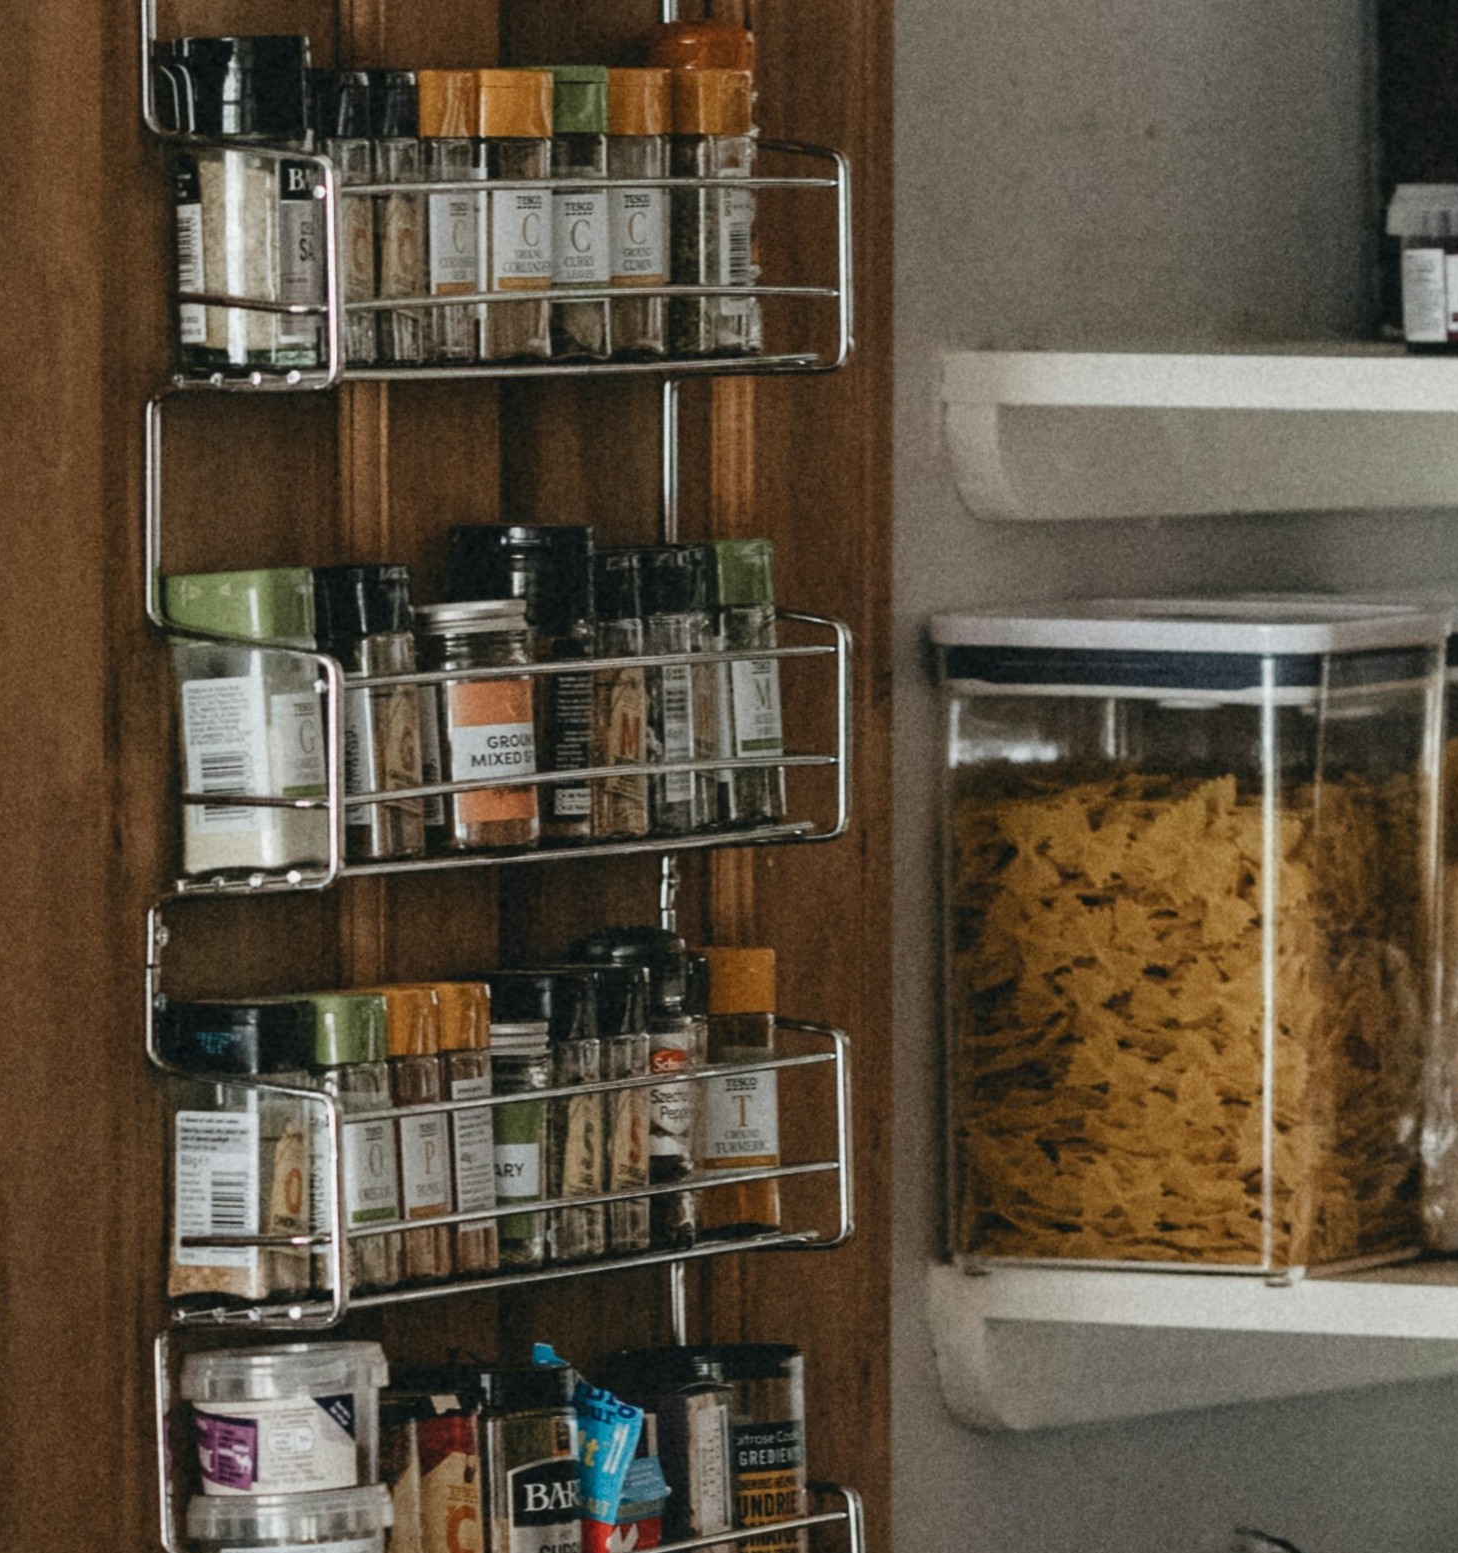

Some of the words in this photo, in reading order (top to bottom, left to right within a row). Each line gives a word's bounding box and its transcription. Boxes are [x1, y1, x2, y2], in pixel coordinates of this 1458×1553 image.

[564, 202, 595, 212] TESCO
[570, 219, 591, 253] C
[627, 212, 647, 245] C
[471, 751, 522, 767] MIXED
[725, 1077, 758, 1088] TESCO
[732, 1094, 752, 1129] T
[523, 1481, 580, 1513] BAR
